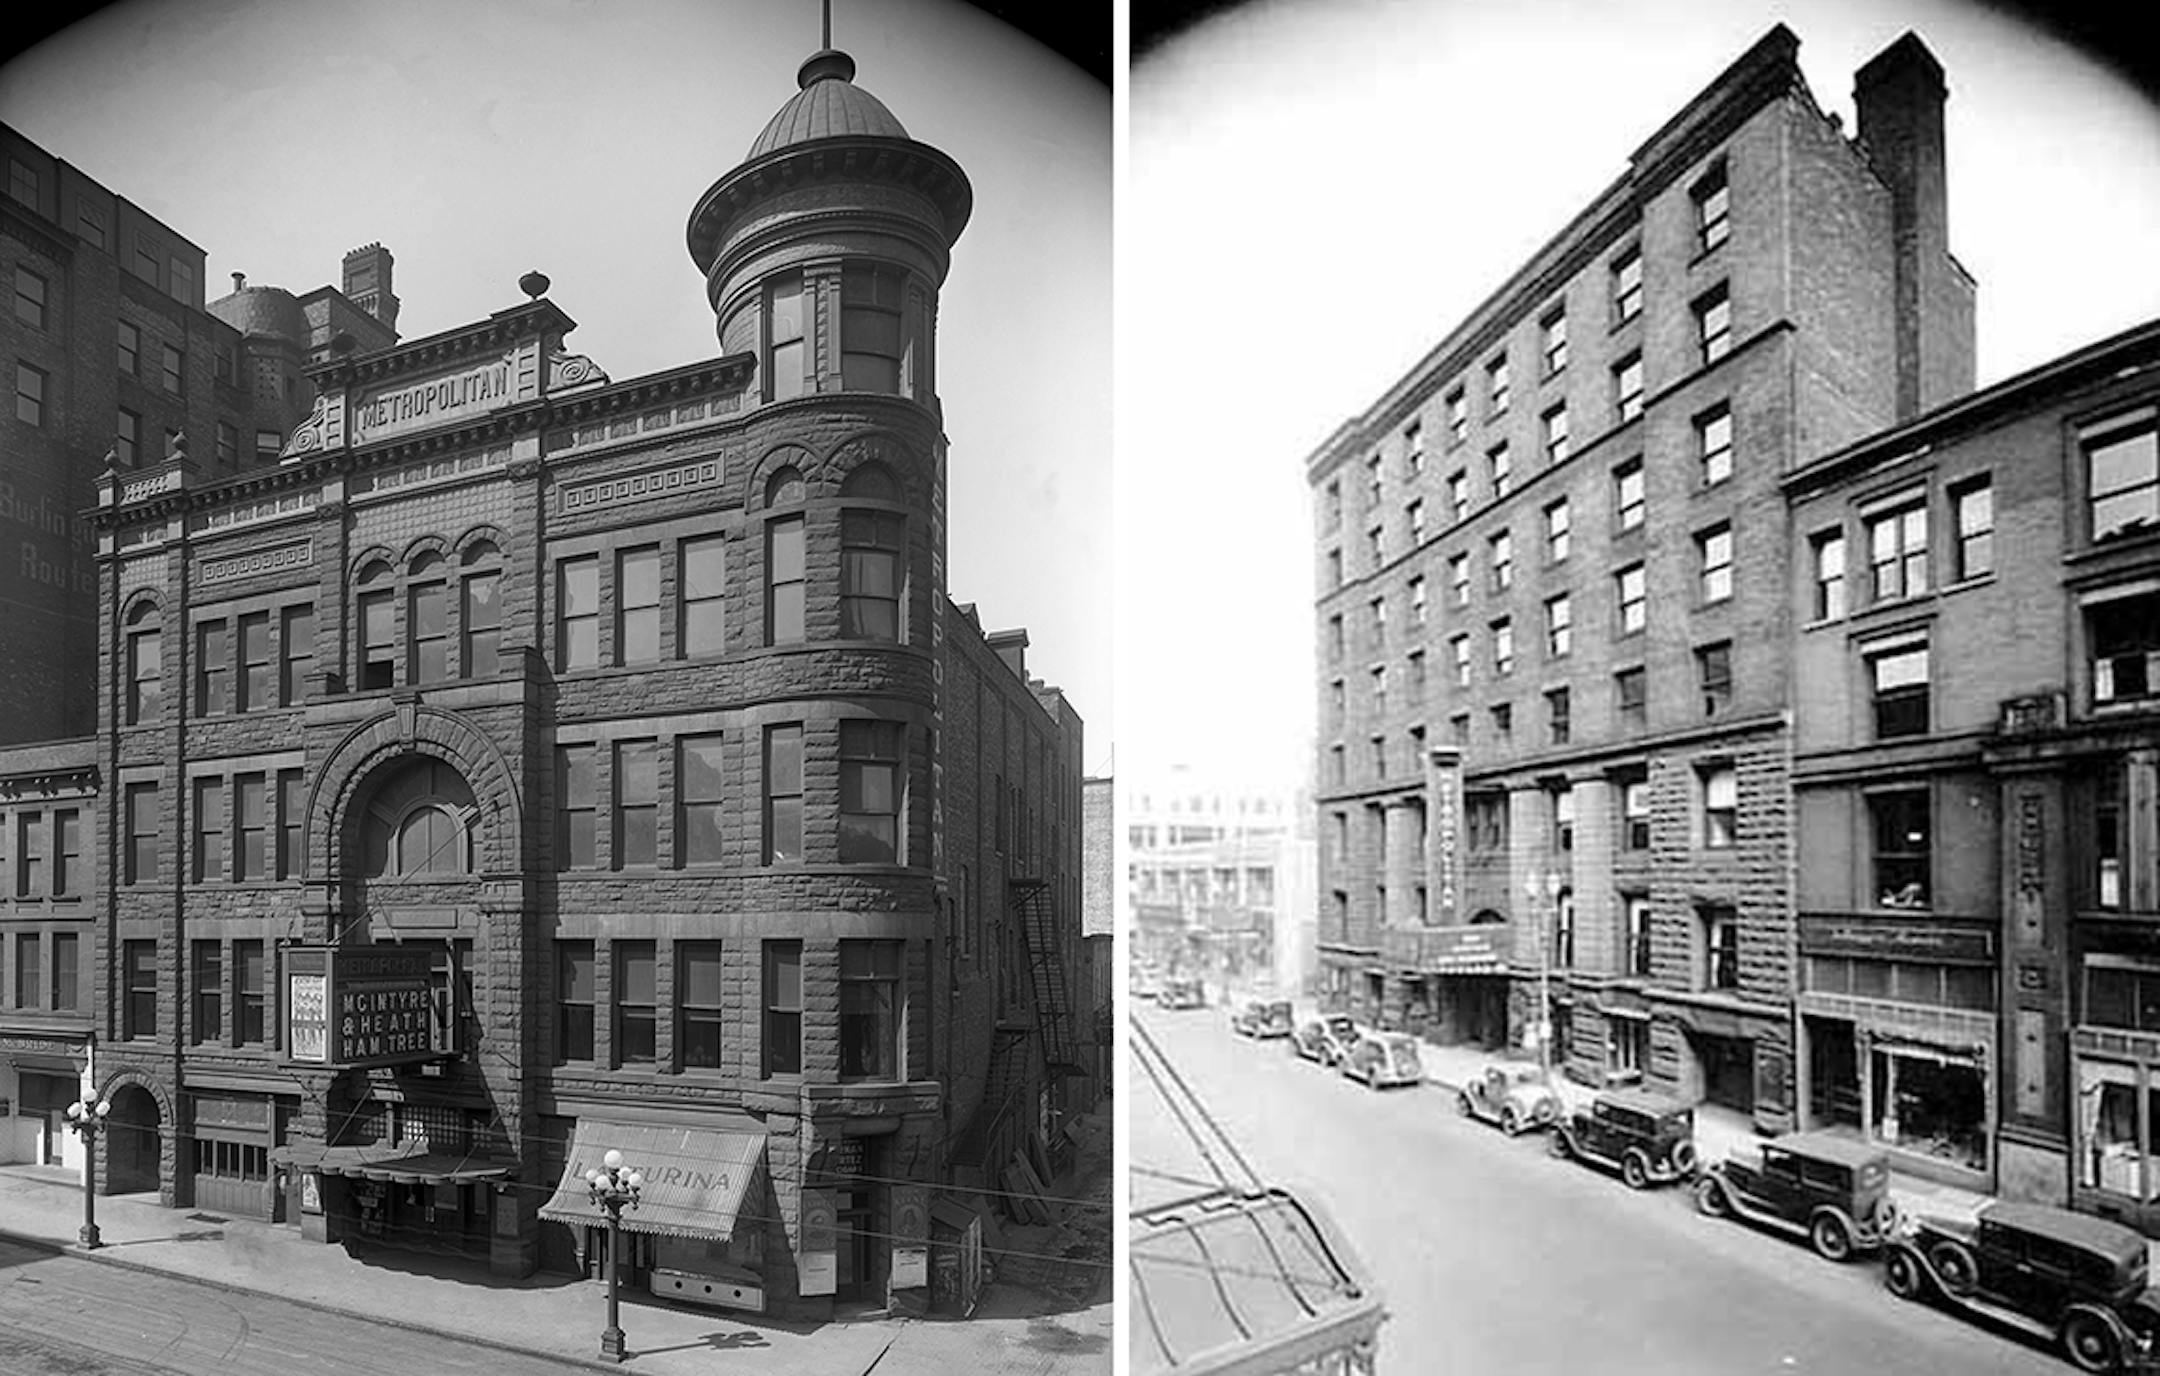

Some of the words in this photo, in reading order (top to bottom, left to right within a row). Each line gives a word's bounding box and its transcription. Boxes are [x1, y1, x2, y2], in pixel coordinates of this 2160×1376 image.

[361, 364, 508, 431] METROPOLITAN
[343, 990, 429, 1013] MCINTYRE
[342, 1016, 355, 1037] &
[387, 1031, 426, 1053] TREE
